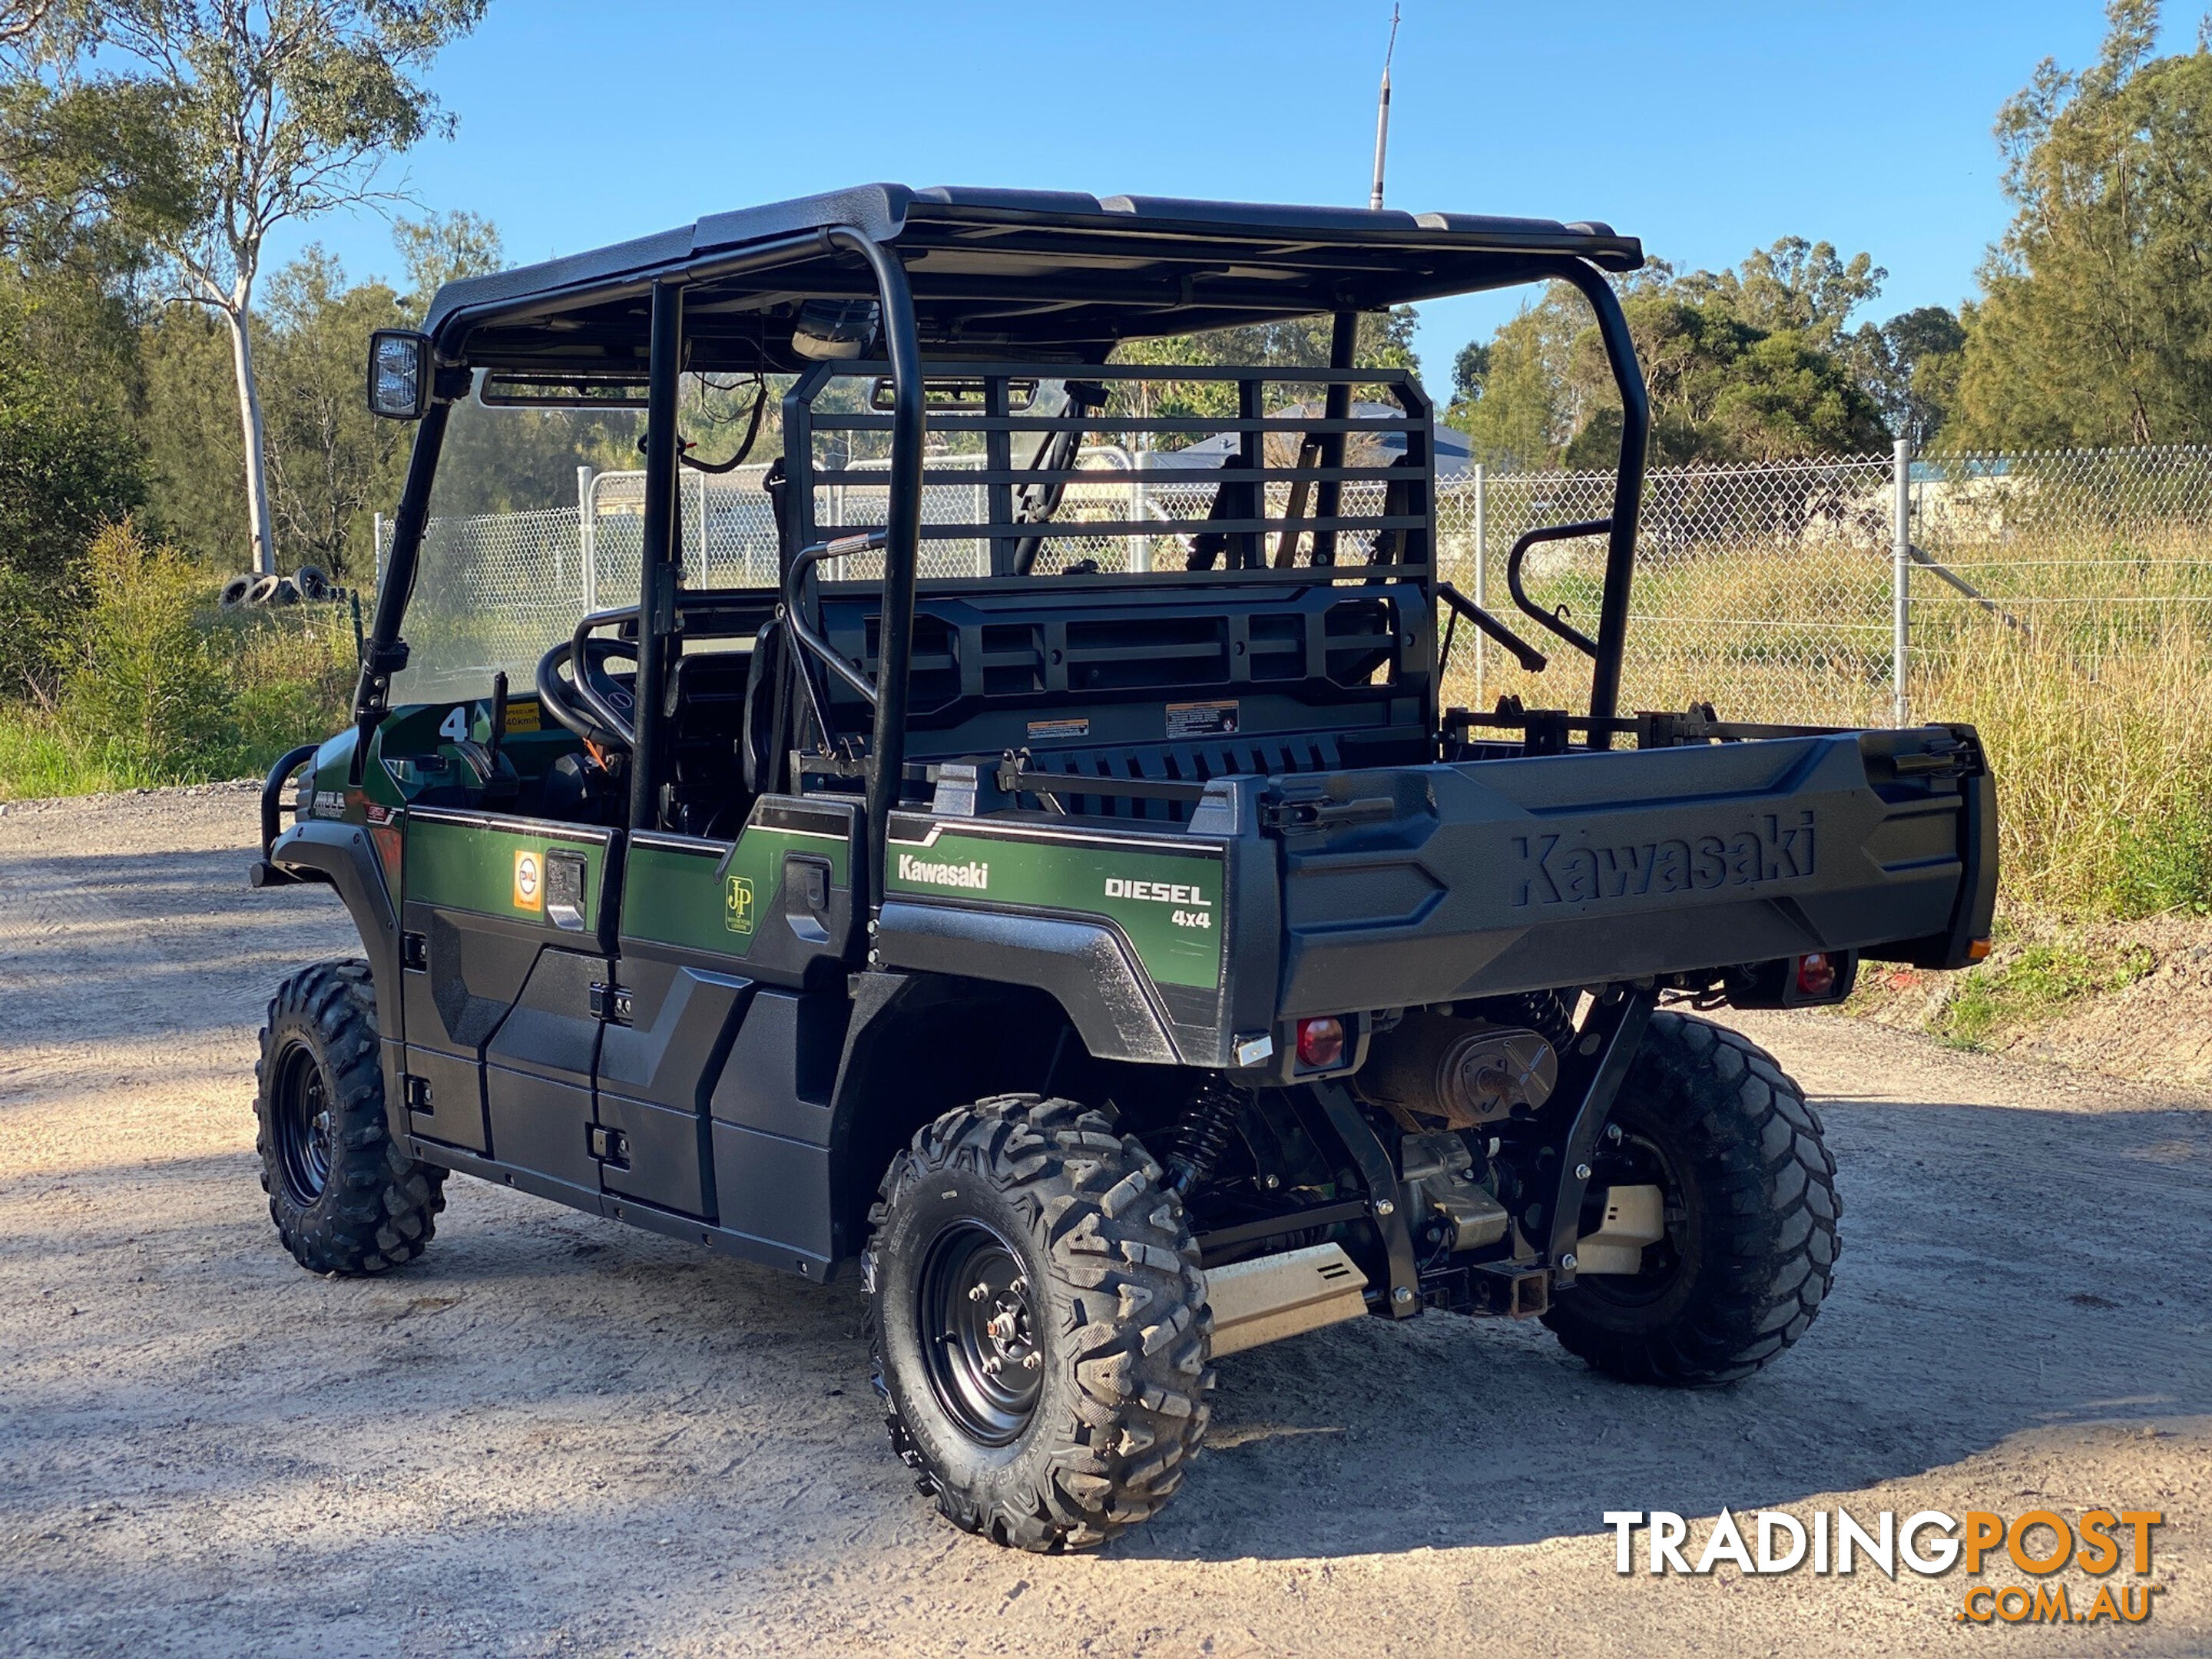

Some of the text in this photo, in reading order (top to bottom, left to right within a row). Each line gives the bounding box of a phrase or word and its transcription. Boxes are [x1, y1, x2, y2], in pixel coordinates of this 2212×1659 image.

[439, 707, 468, 742] 4
[899, 853, 988, 889] Kawasaki
[1510, 810, 1815, 908] Kawasaki
[1104, 877, 1212, 906] DIESEL
[1171, 909, 1212, 929] 4x4
